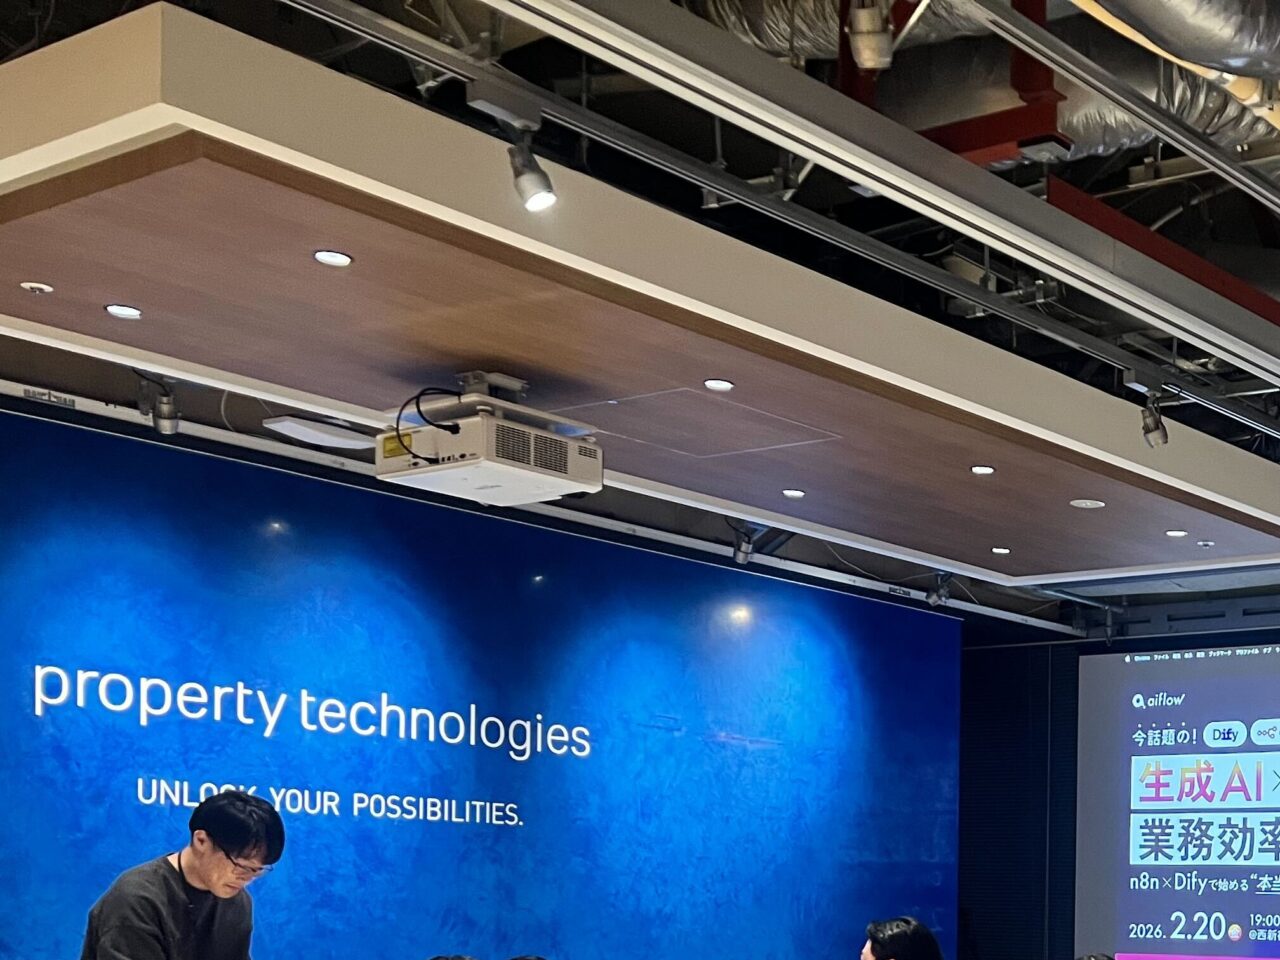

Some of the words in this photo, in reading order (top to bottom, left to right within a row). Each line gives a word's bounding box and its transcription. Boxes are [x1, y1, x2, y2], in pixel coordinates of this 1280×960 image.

[33, 664, 288, 737] property
[300, 689, 592, 761] technologies
[1147, 693, 1186, 707] aiflow
[1213, 728, 1239, 742] Dify
[269, 787, 340, 816] YOUR
[353, 793, 524, 827] POSSIBILITIES.
[1129, 924, 1166, 939] 2026.
[1170, 911, 1226, 940] 2.20
